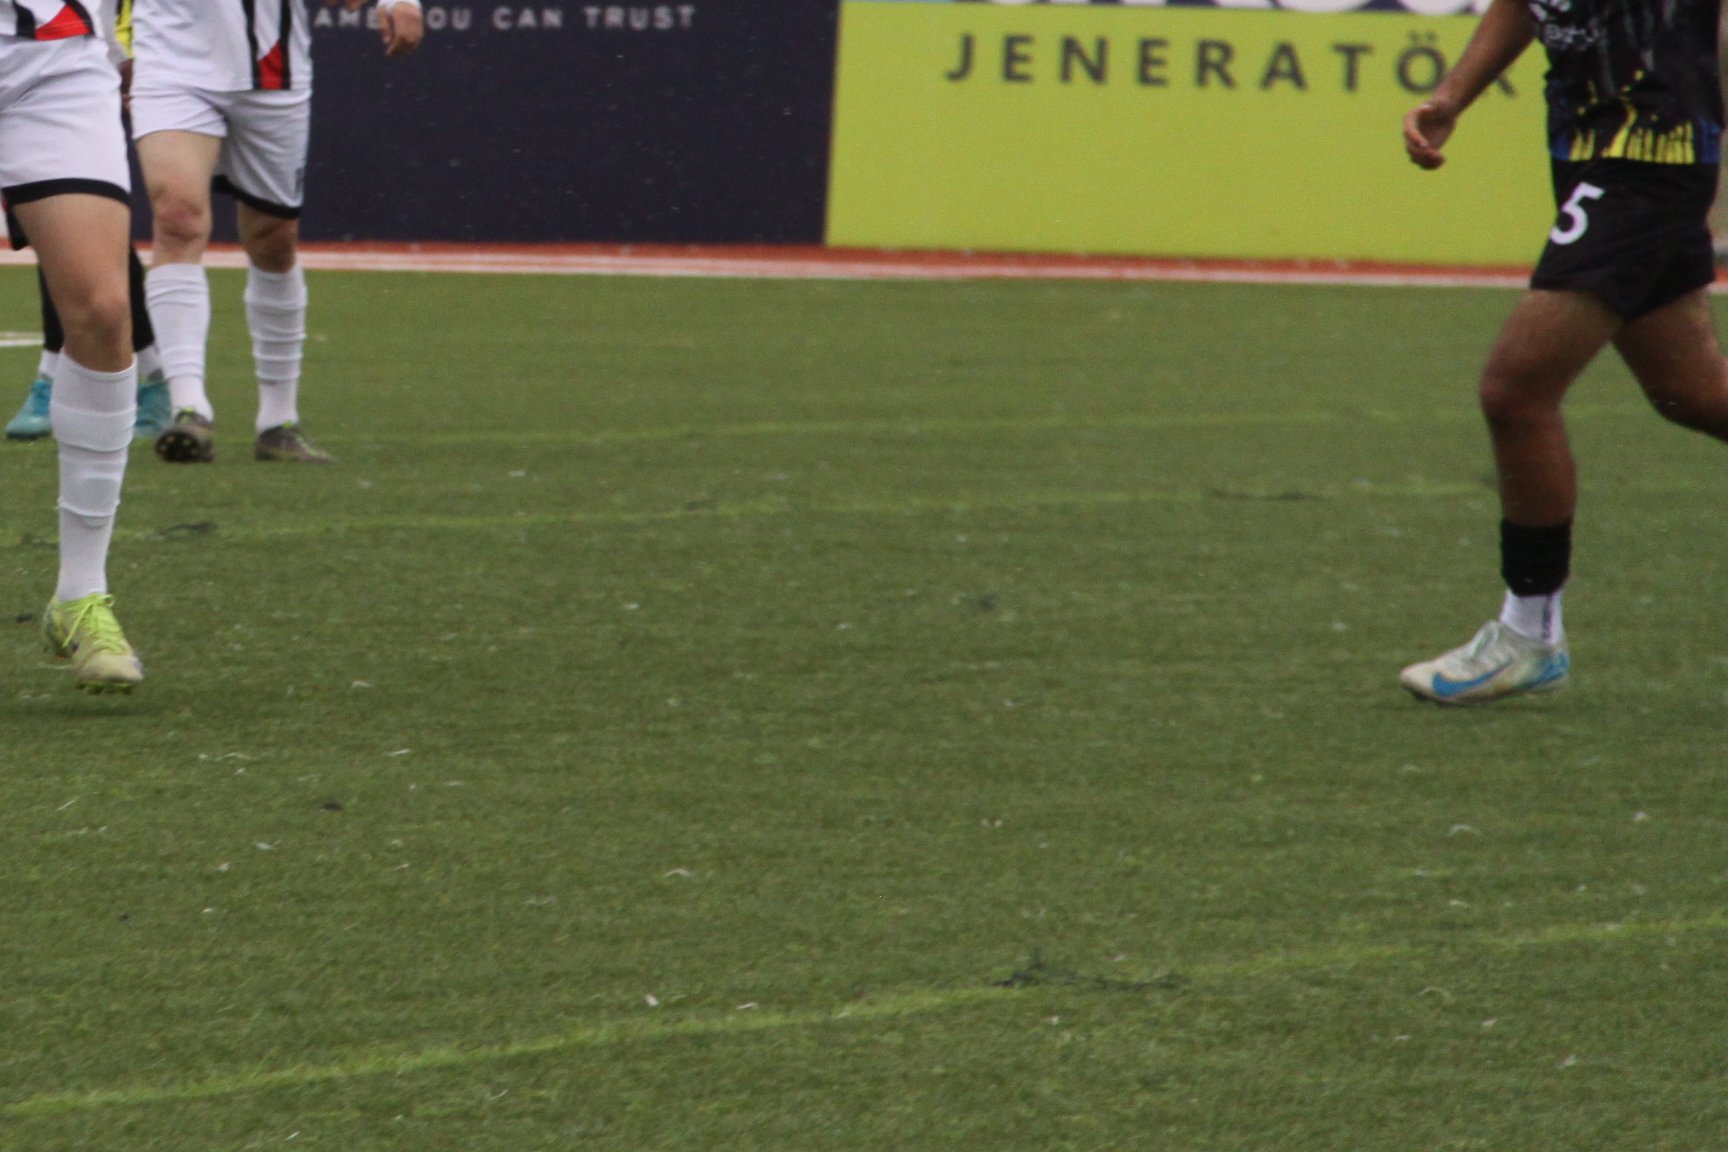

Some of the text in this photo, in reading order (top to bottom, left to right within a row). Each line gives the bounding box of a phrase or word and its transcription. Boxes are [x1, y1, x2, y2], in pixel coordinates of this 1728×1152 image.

[314, 5, 696, 30] AME OU CAN TRUST
[1550, 181, 1606, 244] 5
